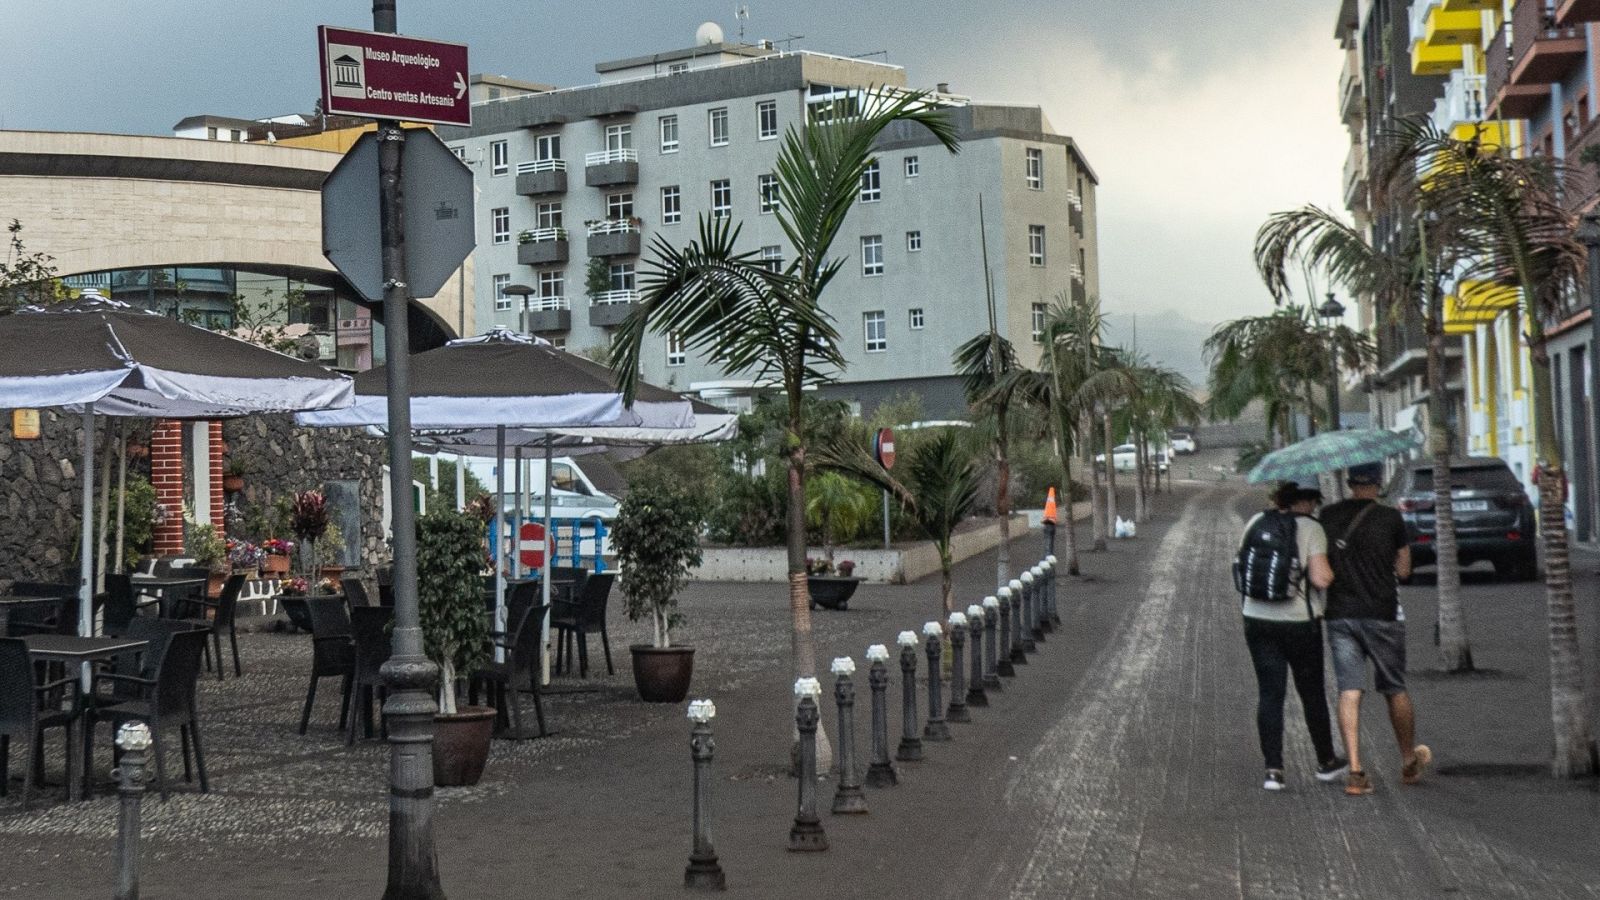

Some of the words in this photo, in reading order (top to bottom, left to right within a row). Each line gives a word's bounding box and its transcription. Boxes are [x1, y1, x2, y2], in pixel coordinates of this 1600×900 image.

[365, 47, 390, 61] Museo
[391, 50, 440, 69] Arqueológico
[367, 86, 392, 101] Centro
[394, 91, 418, 103] ventas
